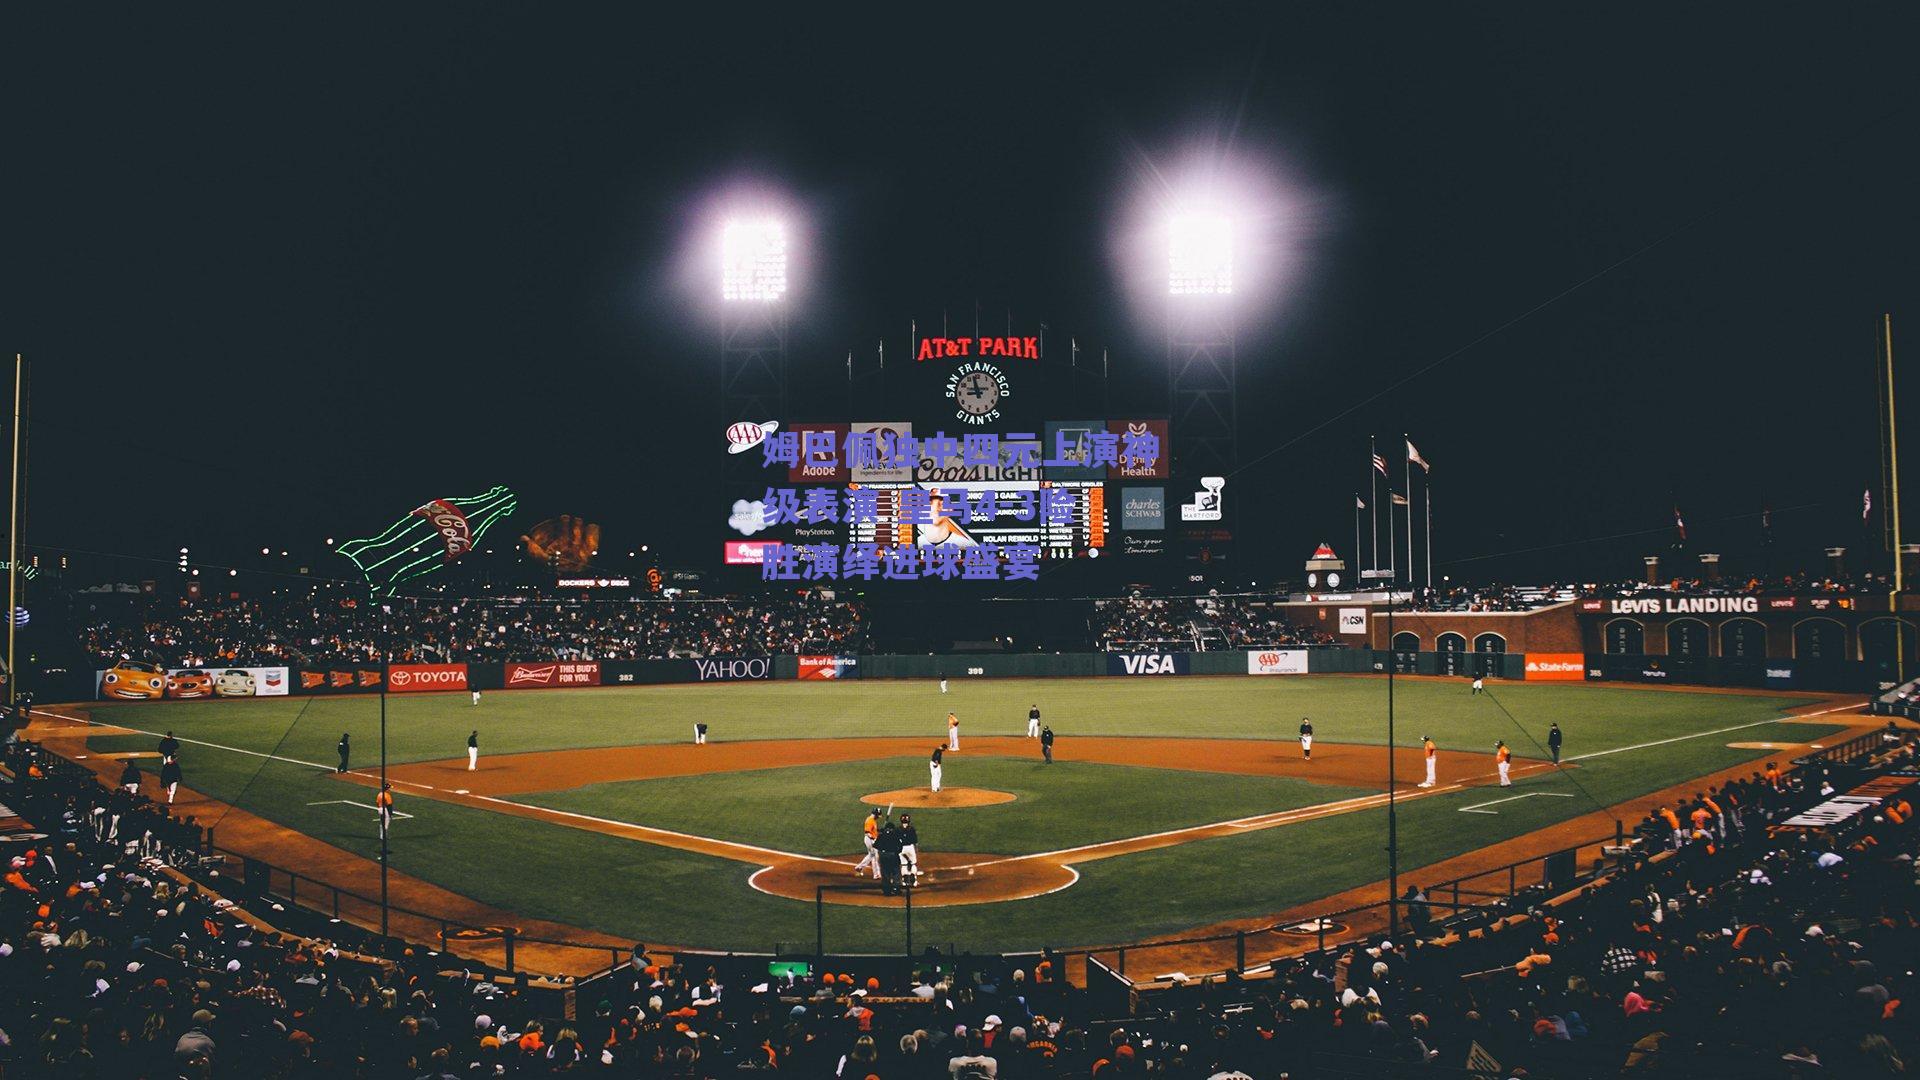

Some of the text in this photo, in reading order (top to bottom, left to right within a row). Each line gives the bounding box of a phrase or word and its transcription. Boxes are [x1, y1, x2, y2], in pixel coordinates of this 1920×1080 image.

[918, 337, 1038, 360] AT&T PARK
[945, 361, 1010, 398] SAN FRANCISCO
[956, 409, 1000, 425] GIANTS
[917, 458, 981, 481] Coors
[1121, 467, 1156, 476] Health
[1125, 498, 1160, 509] charles
[1125, 510, 1161, 518] SCHWAB
[795, 528, 834, 537] PlayStation
[558, 579, 630, 587] DOCKERS DECK
[1666, 597, 1758, 613] LANDING
[1349, 616, 1364, 625] CSN
[800, 658, 857, 666] Bank of America
[1119, 654, 1176, 674] VISA
[559, 664, 597, 673] THIS BUD'S
[695, 658, 771, 681] YAHOO!
[413, 671, 467, 683] TOYOTA
[559, 674, 573, 683] FOR
